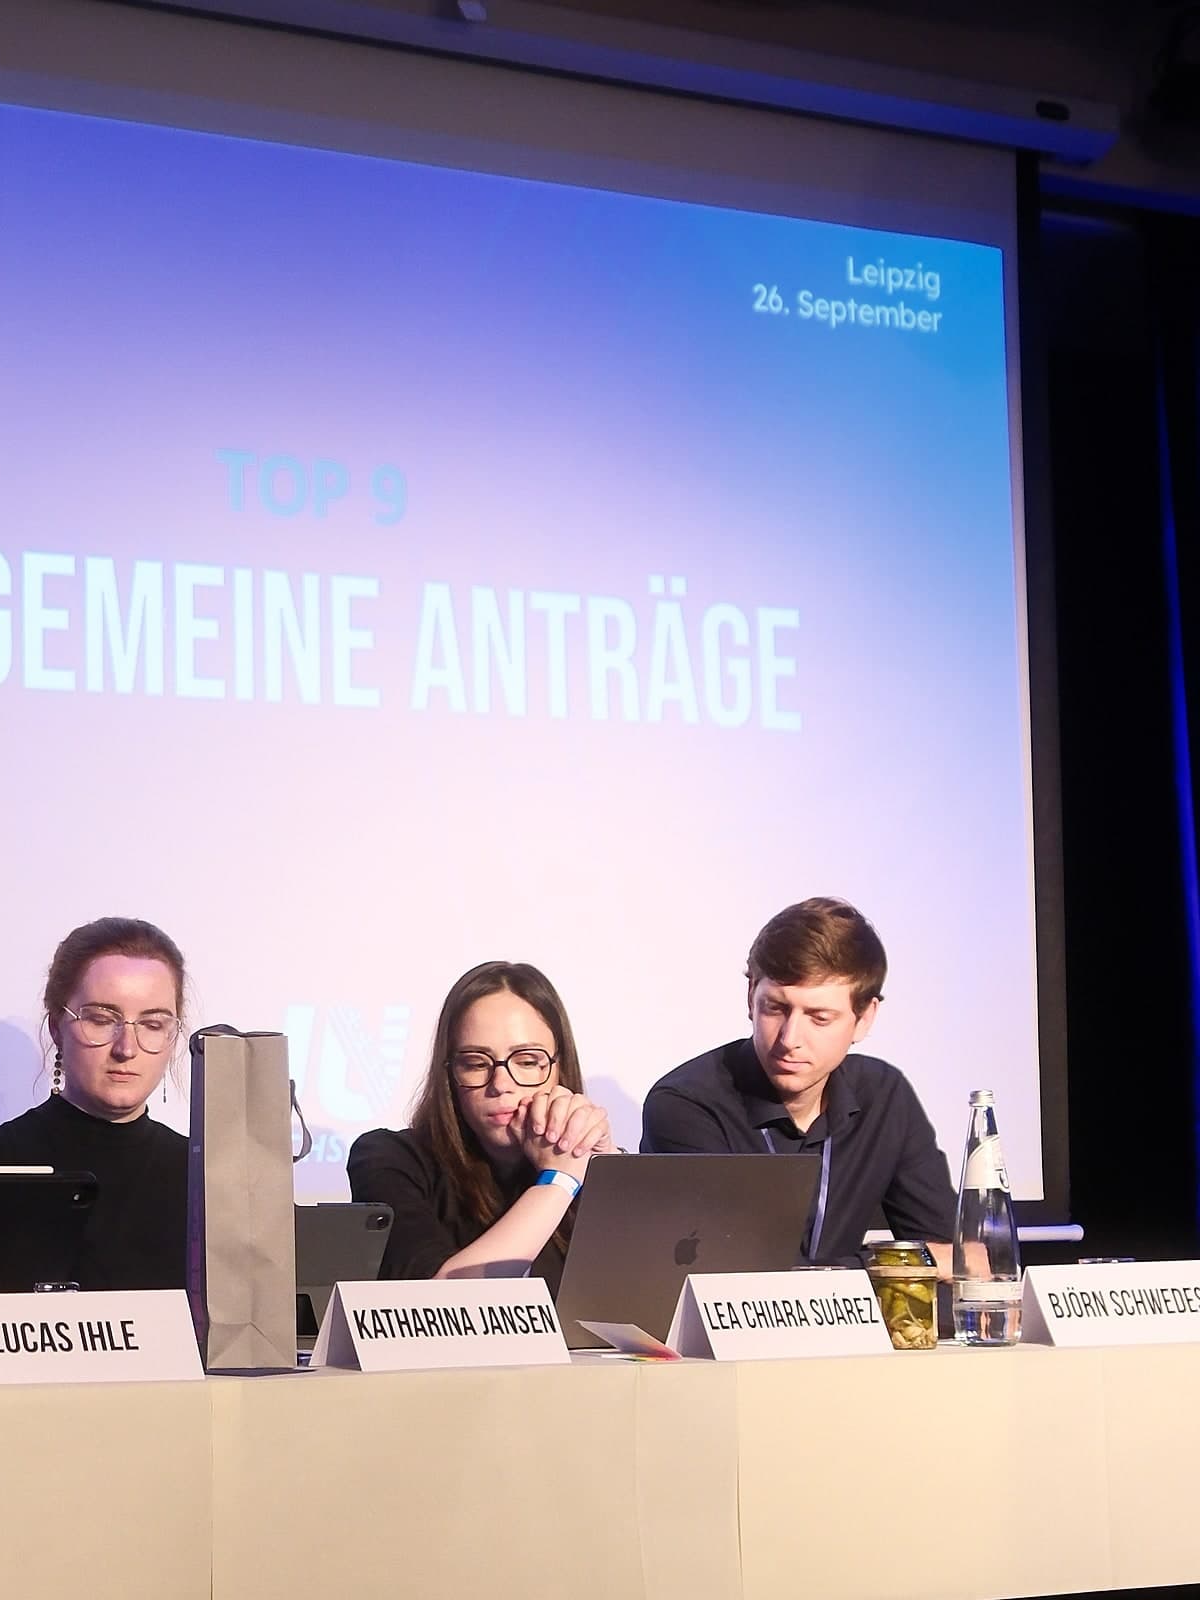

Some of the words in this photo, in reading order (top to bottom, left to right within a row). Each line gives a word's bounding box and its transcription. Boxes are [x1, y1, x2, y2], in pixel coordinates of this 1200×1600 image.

[846, 256, 941, 300] Leipzig
[753, 283, 790, 315] 26.
[798, 290, 943, 332] September
[215, 447, 351, 519] TOP
[372, 463, 411, 527] 9
[411, 575, 802, 732] ANTRÄGE
[353, 1308, 477, 1340] KATHARINA
[482, 1304, 558, 1335] JANSEN
[704, 1302, 742, 1330] LEA
[742, 1299, 810, 1329] CHIARA
[810, 1292, 879, 1326] SUÁREZ
[1048, 1286, 1109, 1318] BJÖRN
[79, 1320, 139, 1352] IHLE
